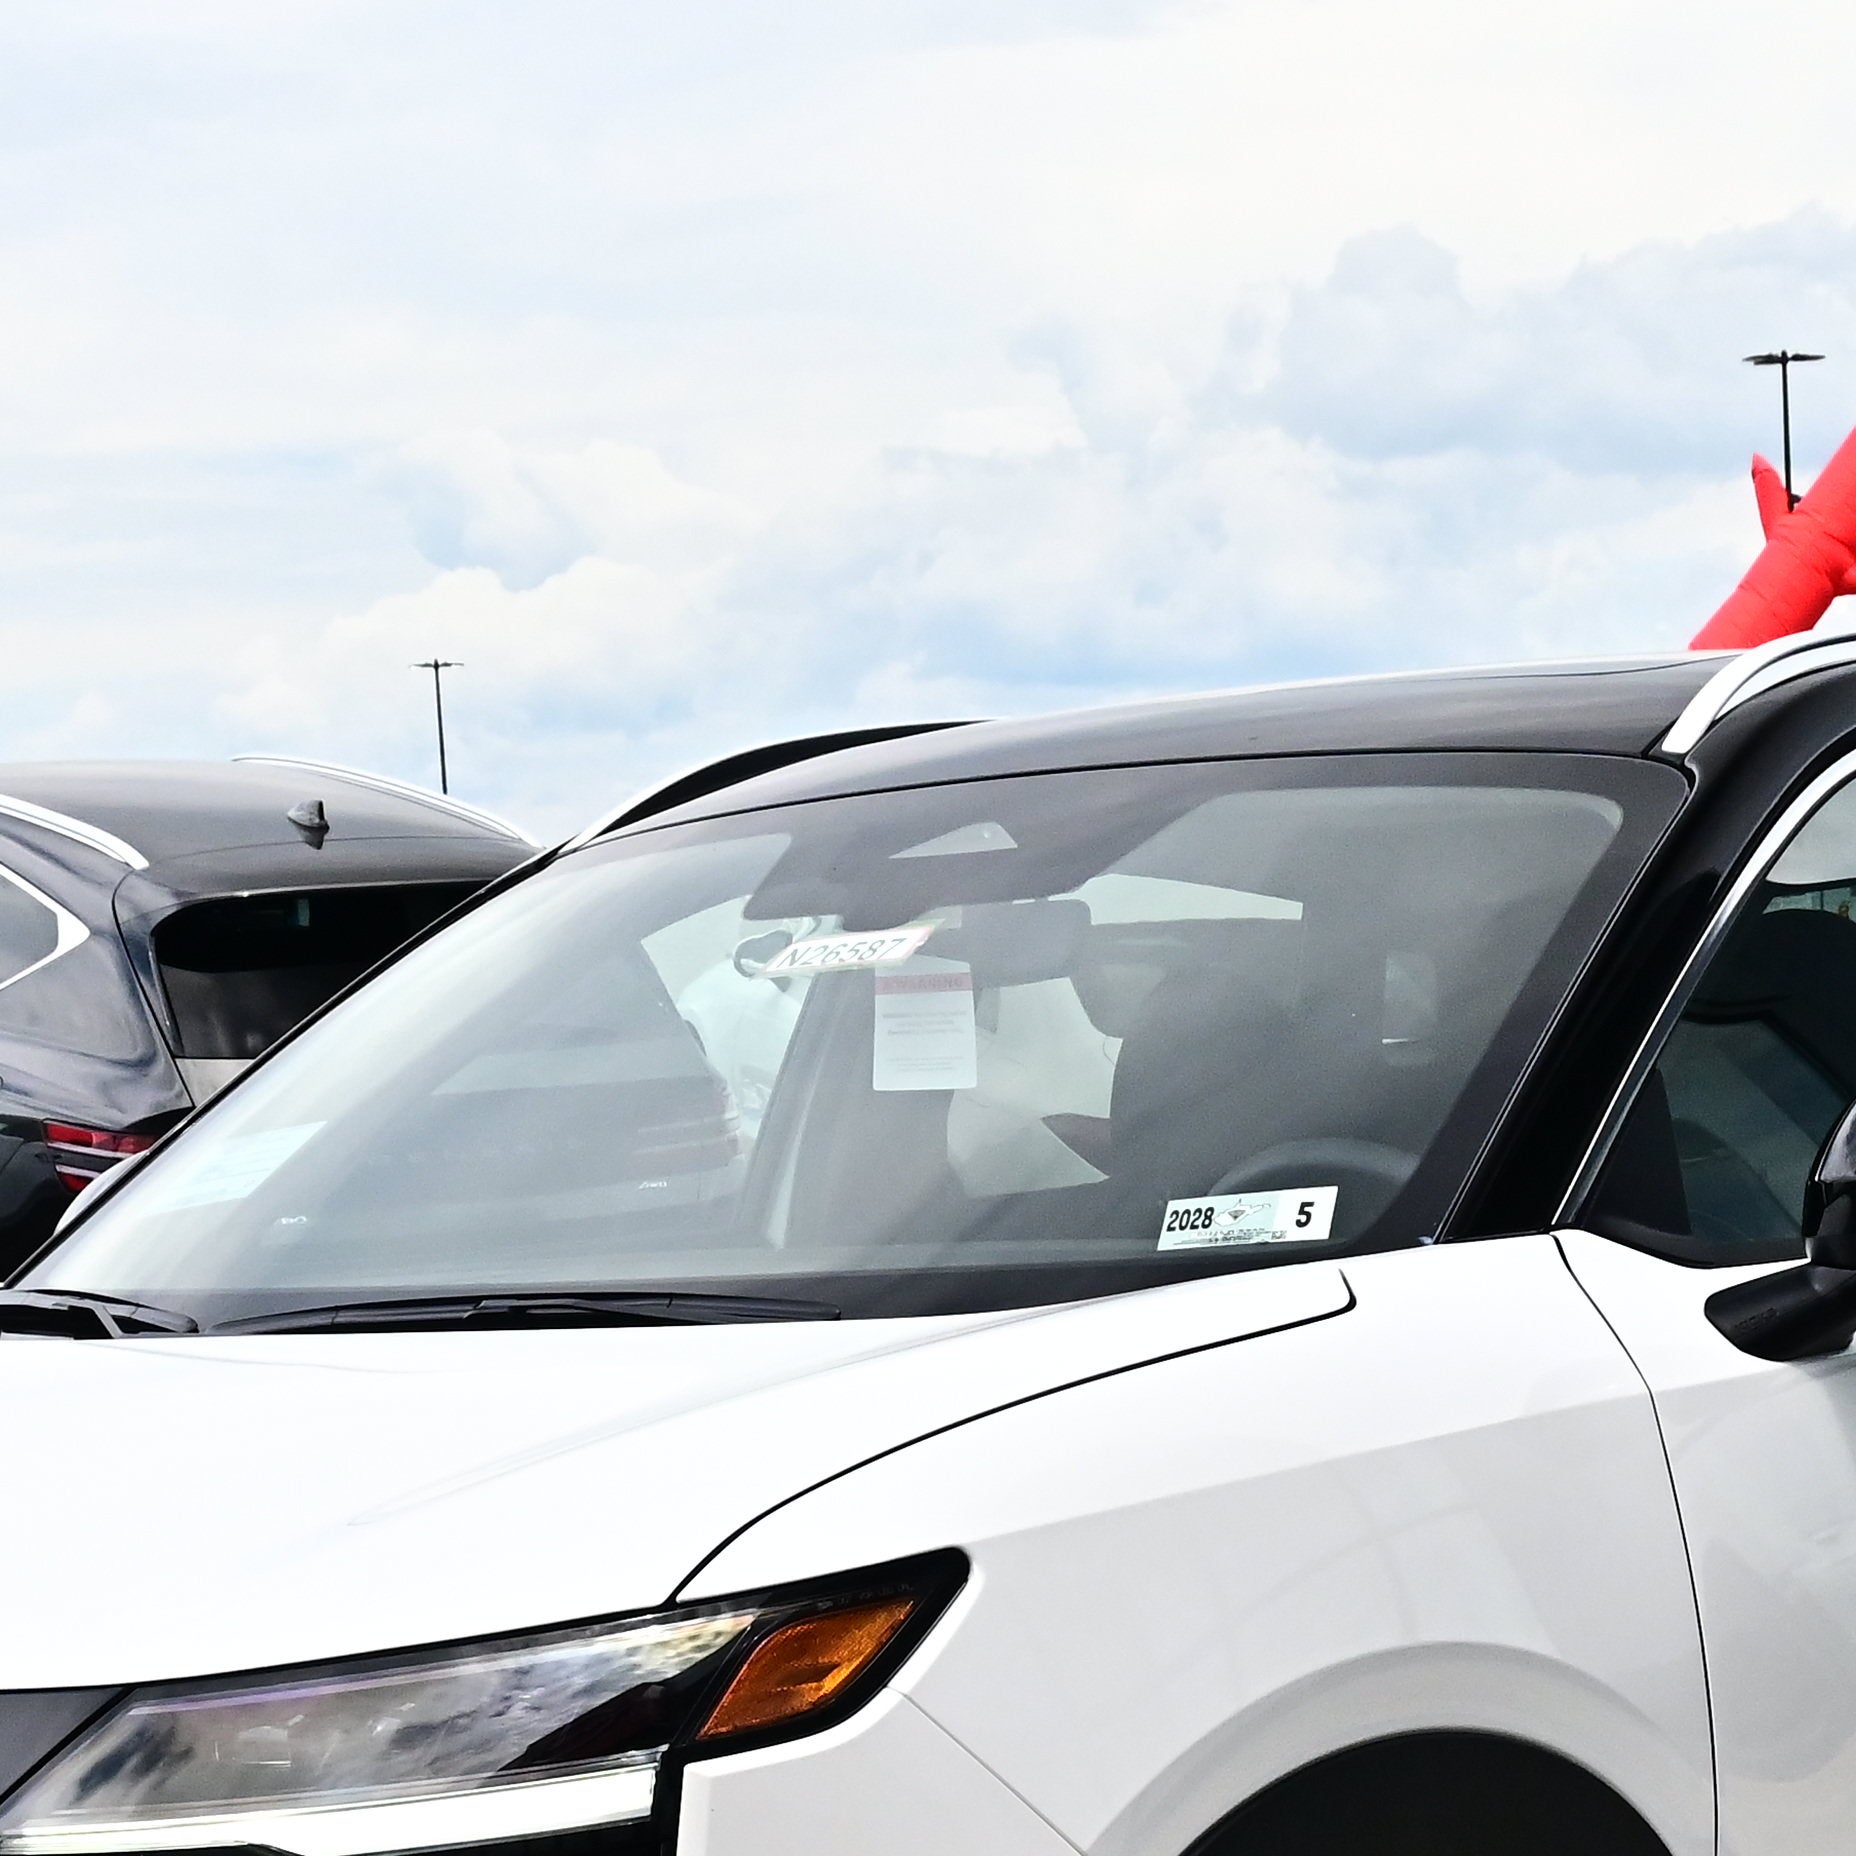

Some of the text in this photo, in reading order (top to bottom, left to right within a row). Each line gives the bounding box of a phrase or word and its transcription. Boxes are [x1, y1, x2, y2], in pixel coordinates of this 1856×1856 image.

[776, 937, 908, 968] N26587
[1166, 1201, 1315, 1233] 2028 5
